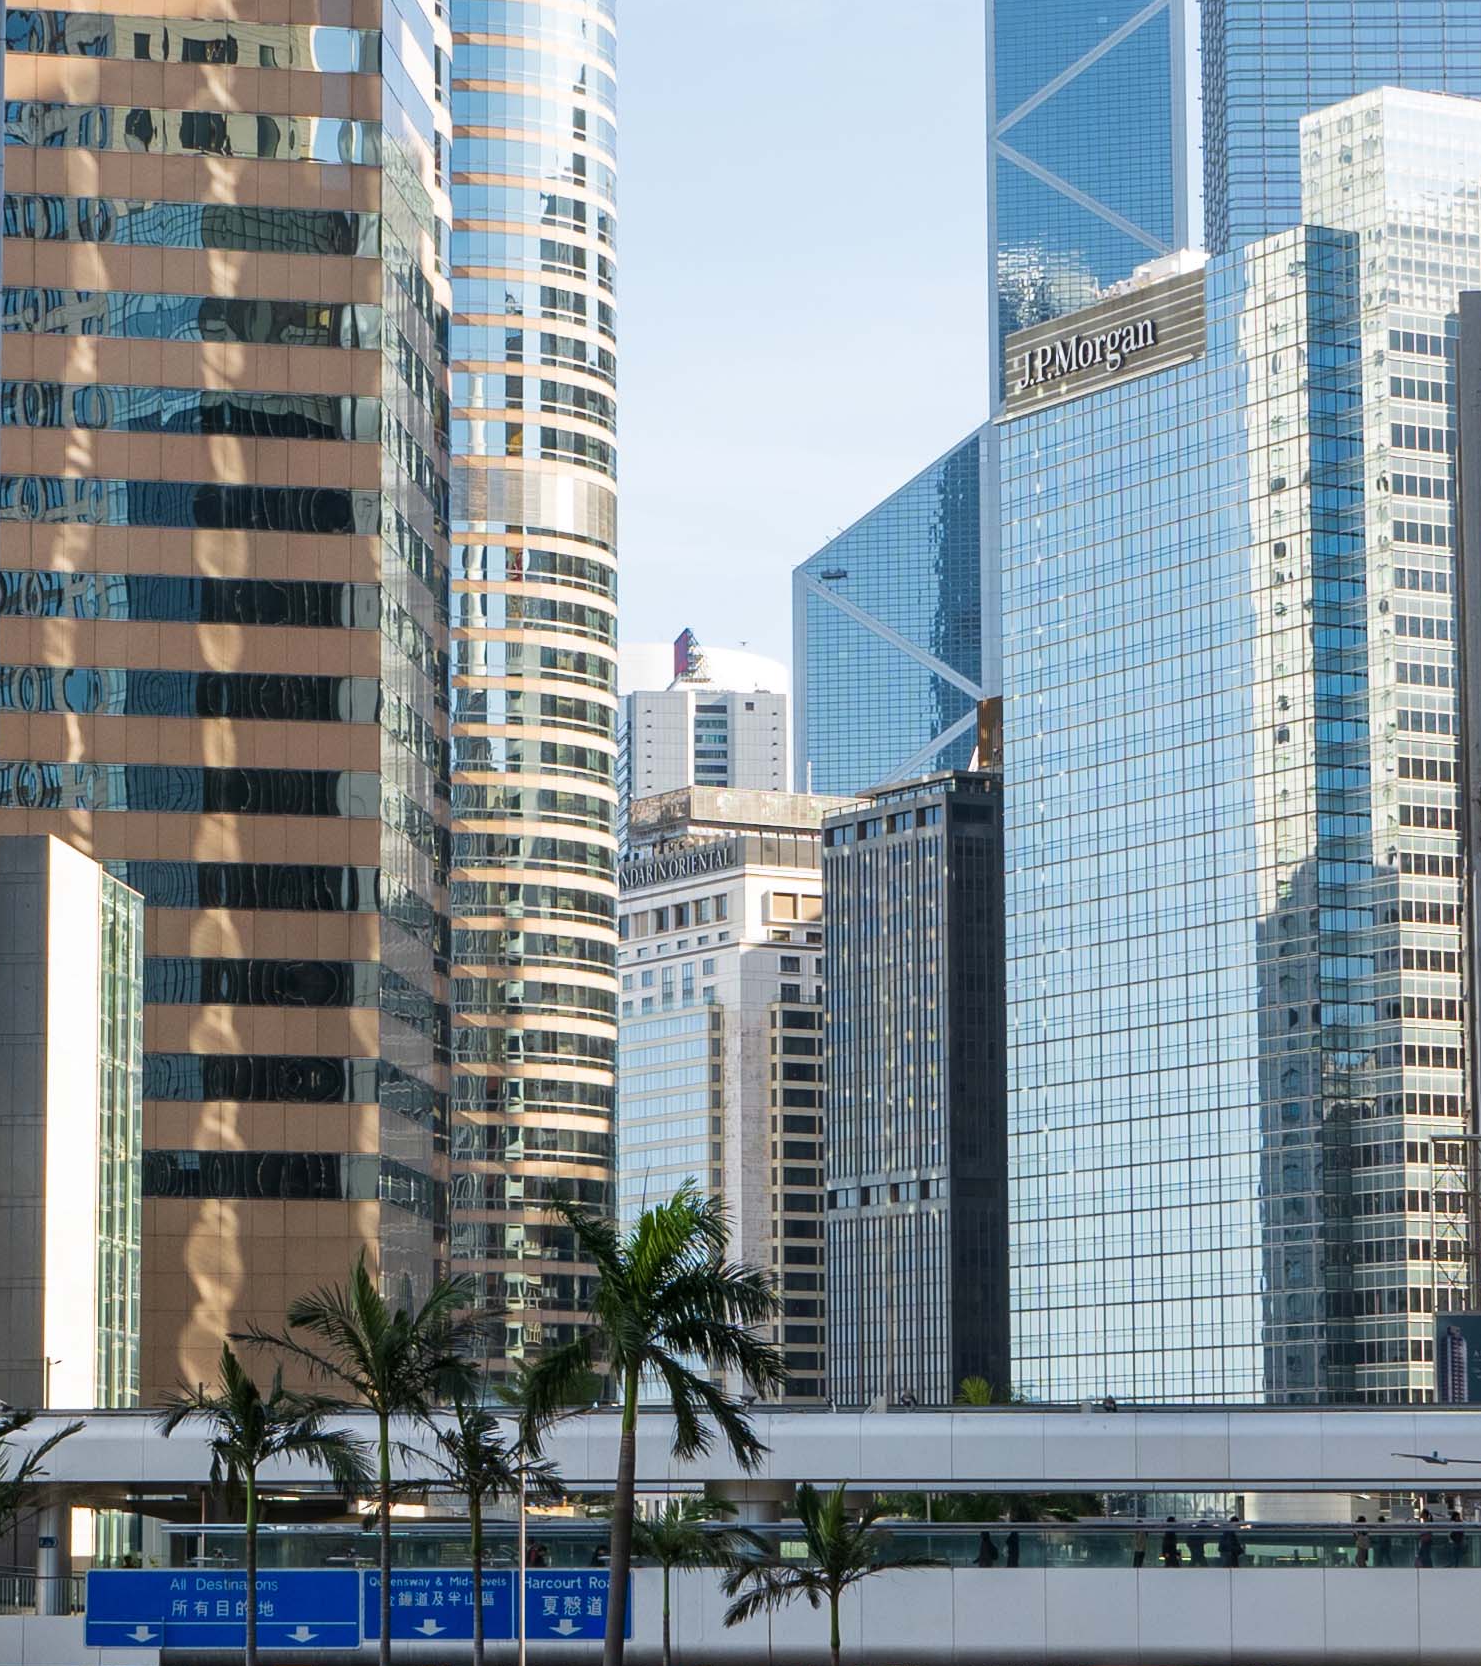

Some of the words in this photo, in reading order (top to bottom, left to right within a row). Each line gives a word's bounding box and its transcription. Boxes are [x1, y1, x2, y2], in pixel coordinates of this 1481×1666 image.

[1018, 319, 1156, 389] J.P.Morgan
[620, 861, 667, 887] NDARIN
[669, 848, 729, 878] ORIENTAL
[170, 1578, 186, 1591] All
[195, 1578, 279, 1591] Destinaons
[369, 1576, 430, 1589] Quensway
[435, 1577, 443, 1586] &
[449, 1576, 507, 1586] Mid-evels
[171, 1599, 275, 1618] 所有目的地
